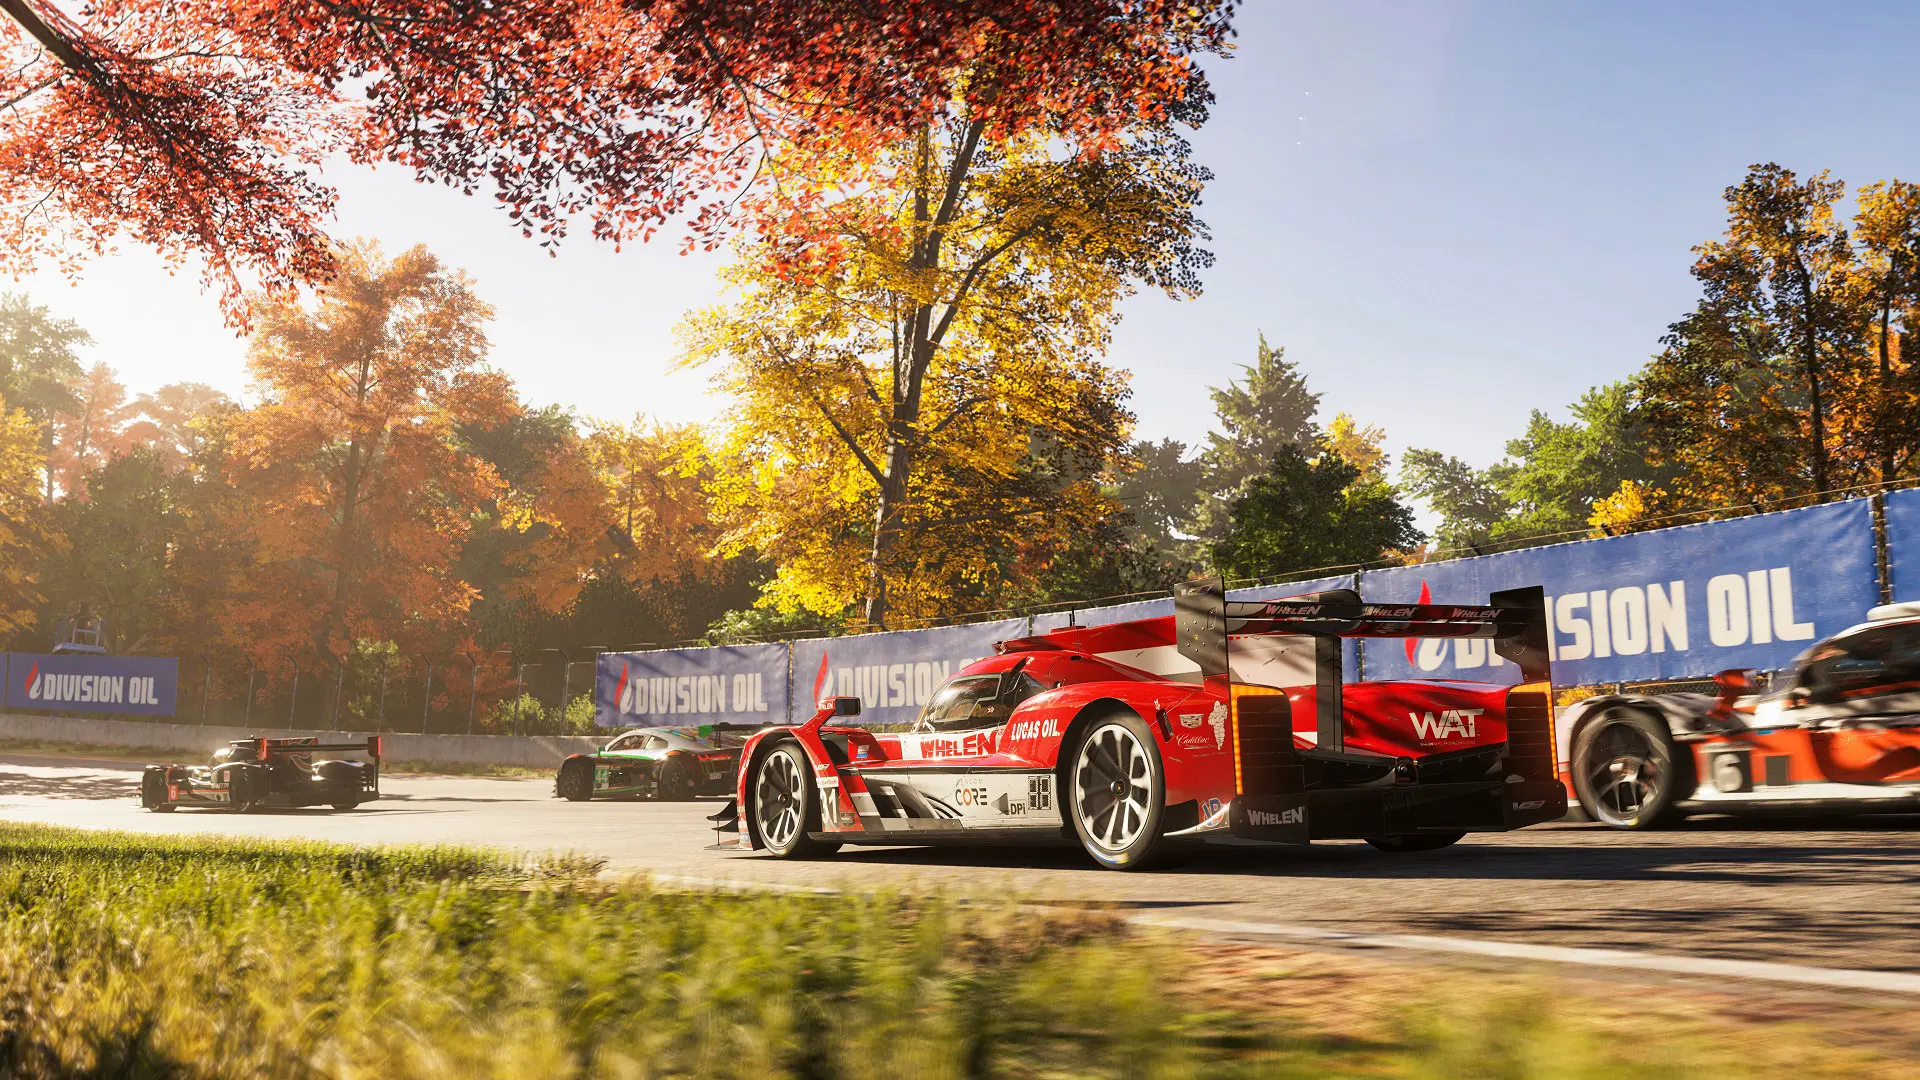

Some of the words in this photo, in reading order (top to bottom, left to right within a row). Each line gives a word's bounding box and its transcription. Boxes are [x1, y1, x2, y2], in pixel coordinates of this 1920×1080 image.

[1266, 604, 1321, 615] WHELEN
[1452, 608, 1501, 618] WHELEN
[1454, 580, 1689, 669] SION
[1707, 566, 1816, 647] OIL
[44, 673, 123, 703] DIVISION
[129, 677, 158, 705] OIL
[636, 675, 725, 714] DIVISION
[733, 672, 768, 712] OIL
[837, 660, 949, 708] DIVISION
[1011, 722, 1040, 741] LUCAS
[1409, 708, 1484, 740] WAT
[920, 732, 997, 758] WHELEN
[1176, 733, 1209, 746] Cadillac
[1713, 752, 1744, 793] 6
[955, 788, 988, 806] CORE
[1010, 803, 1026, 815] DPi
[1247, 807, 1304, 826] WHELEN
